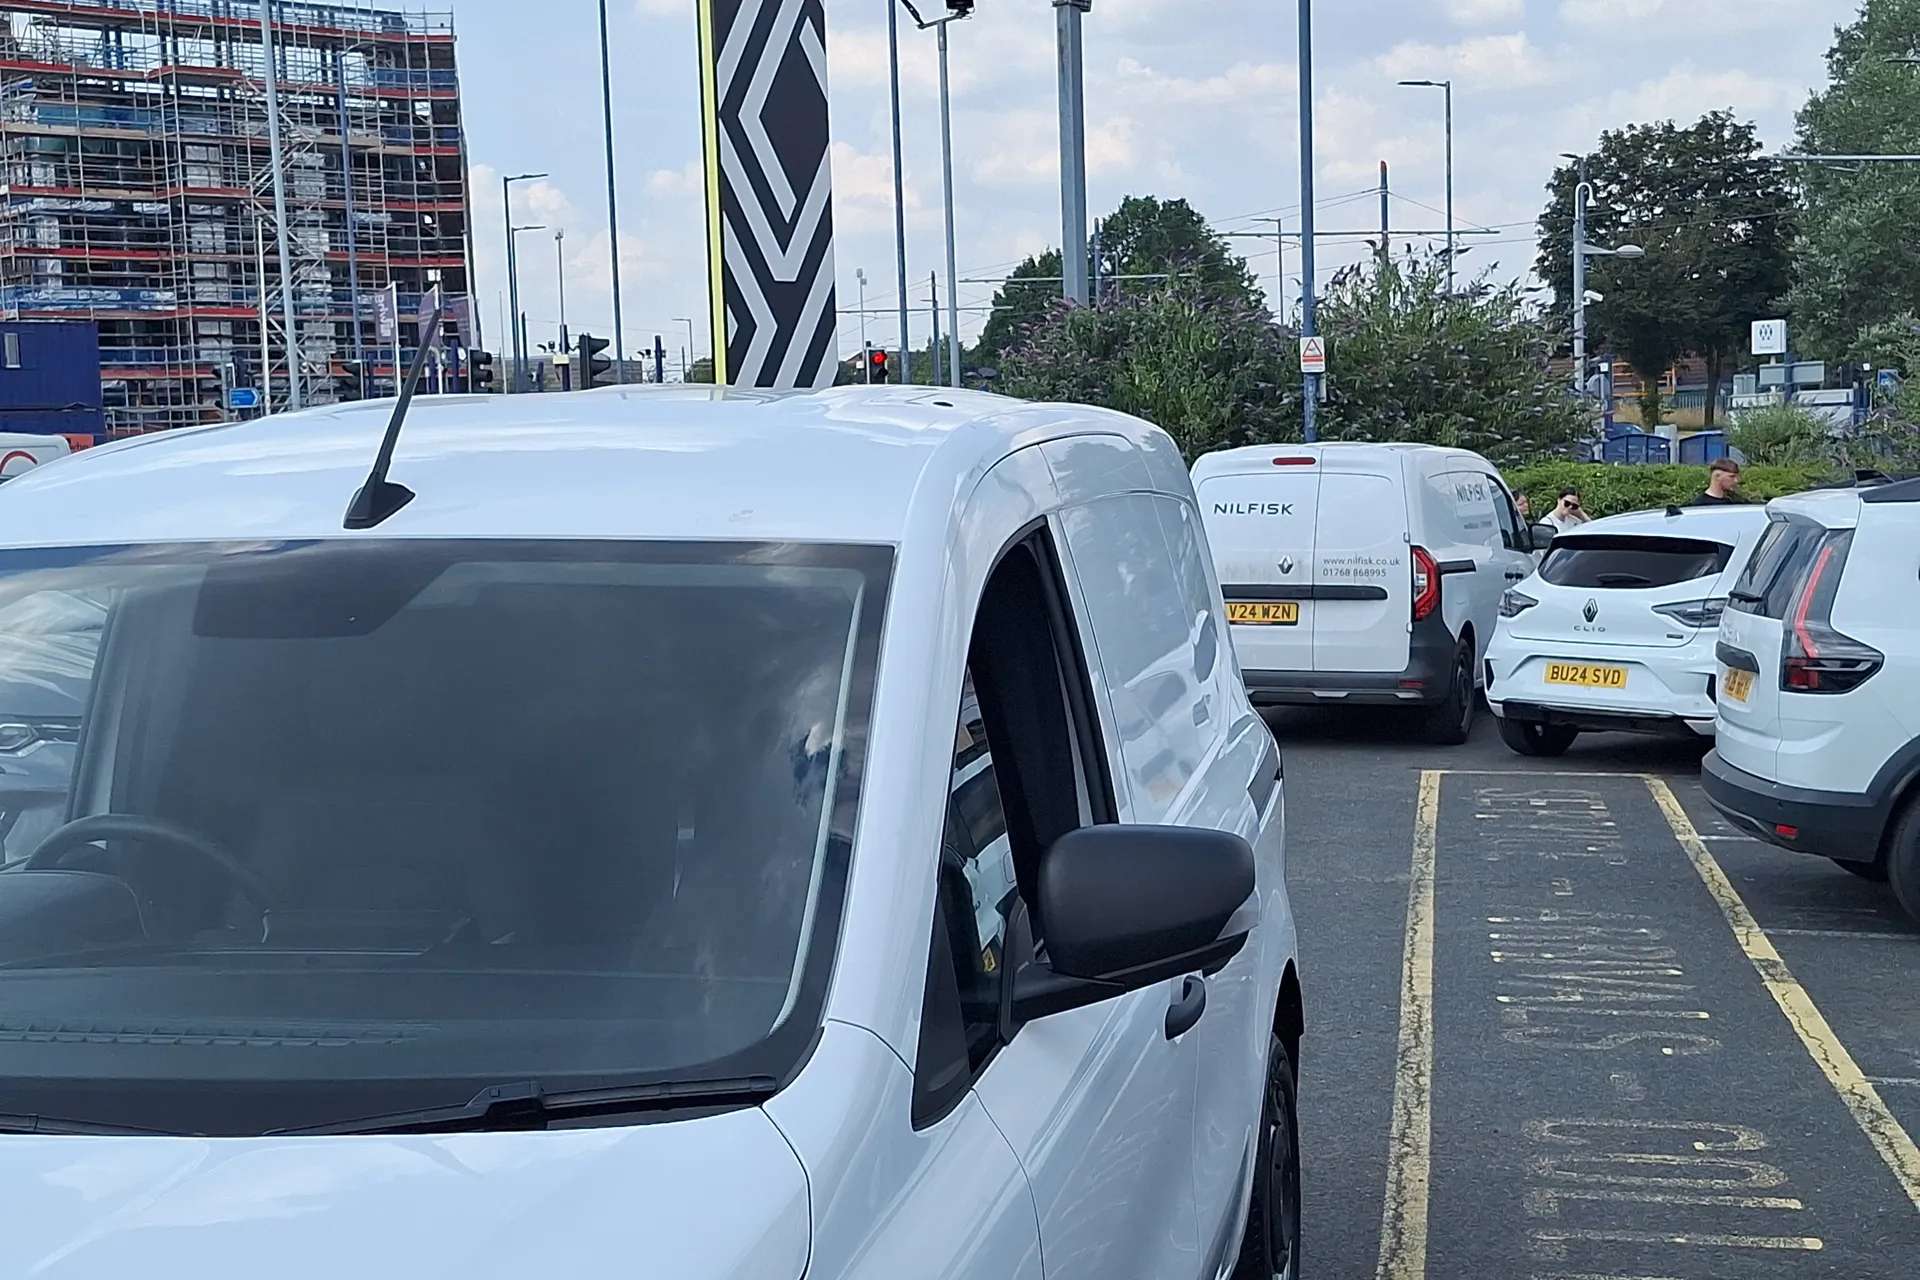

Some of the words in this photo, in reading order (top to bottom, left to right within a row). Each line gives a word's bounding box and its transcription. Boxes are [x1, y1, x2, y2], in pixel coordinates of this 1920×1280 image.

[1213, 503, 1294, 515] NILFISK
[1322, 556, 1400, 566] www.nilfisk.co.uk
[1322, 568, 1350, 577] 01768
[1353, 568, 1386, 577] 868995
[1262, 605, 1291, 619] WZN
[1550, 665, 1588, 681] BU24
[1591, 668, 1621, 685] SVD
[1521, 1117, 1824, 1280] COLL
